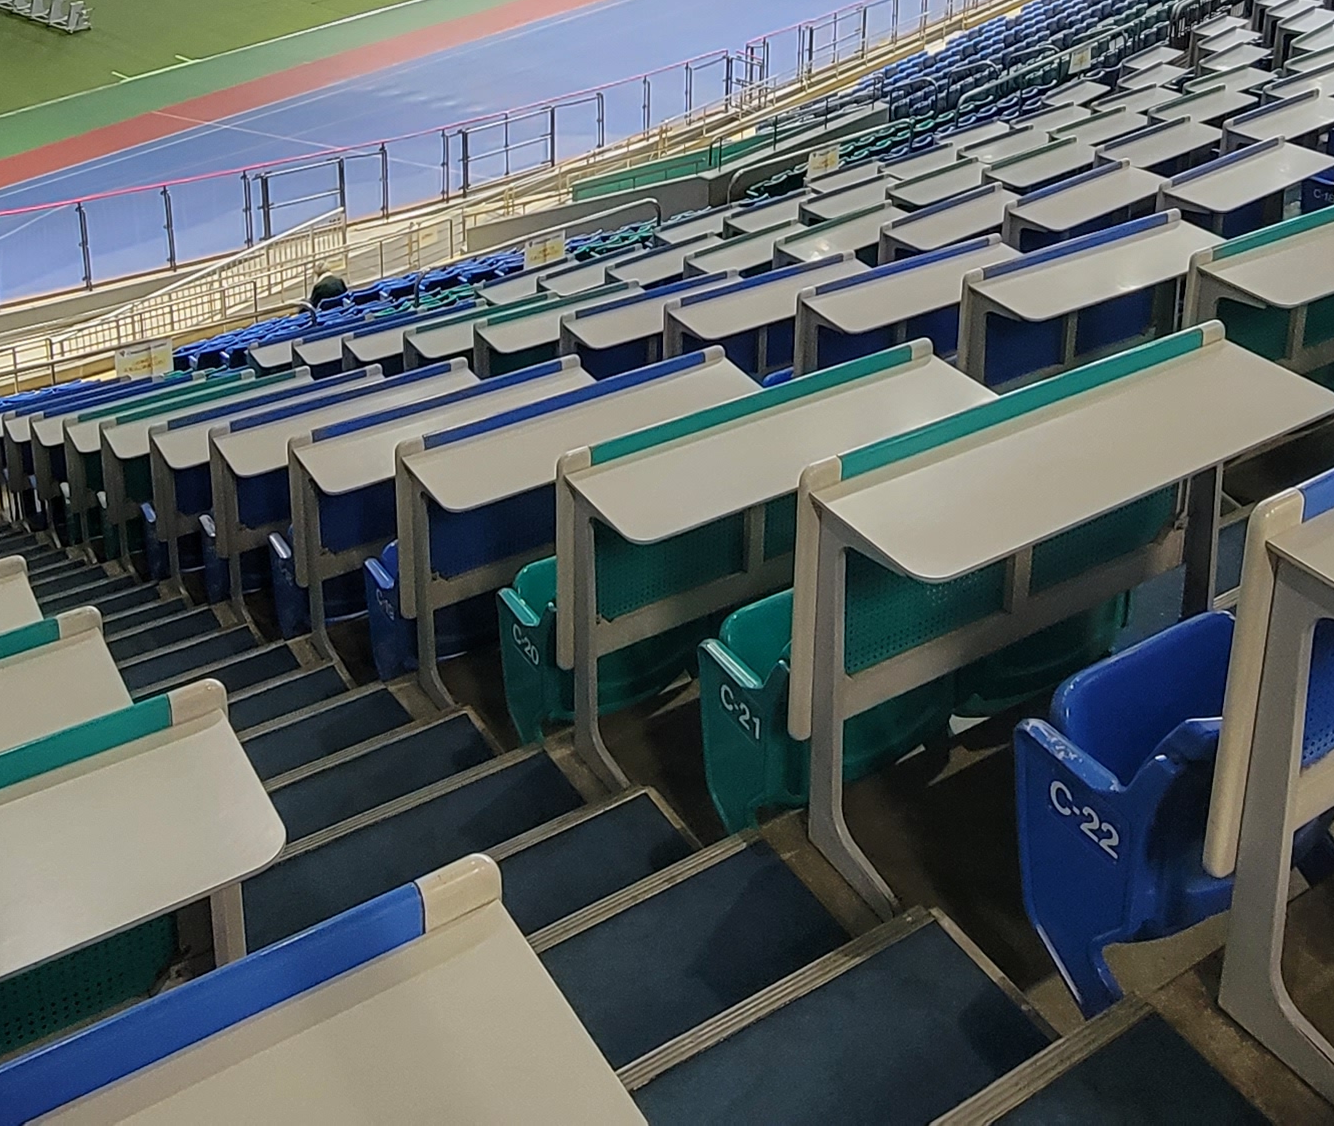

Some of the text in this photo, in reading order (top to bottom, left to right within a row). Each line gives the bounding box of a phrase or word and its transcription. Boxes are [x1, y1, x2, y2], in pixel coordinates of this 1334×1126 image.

[512, 623, 540, 666] C-20
[719, 683, 762, 740] C-21
[1047, 779, 1121, 861] C-22
